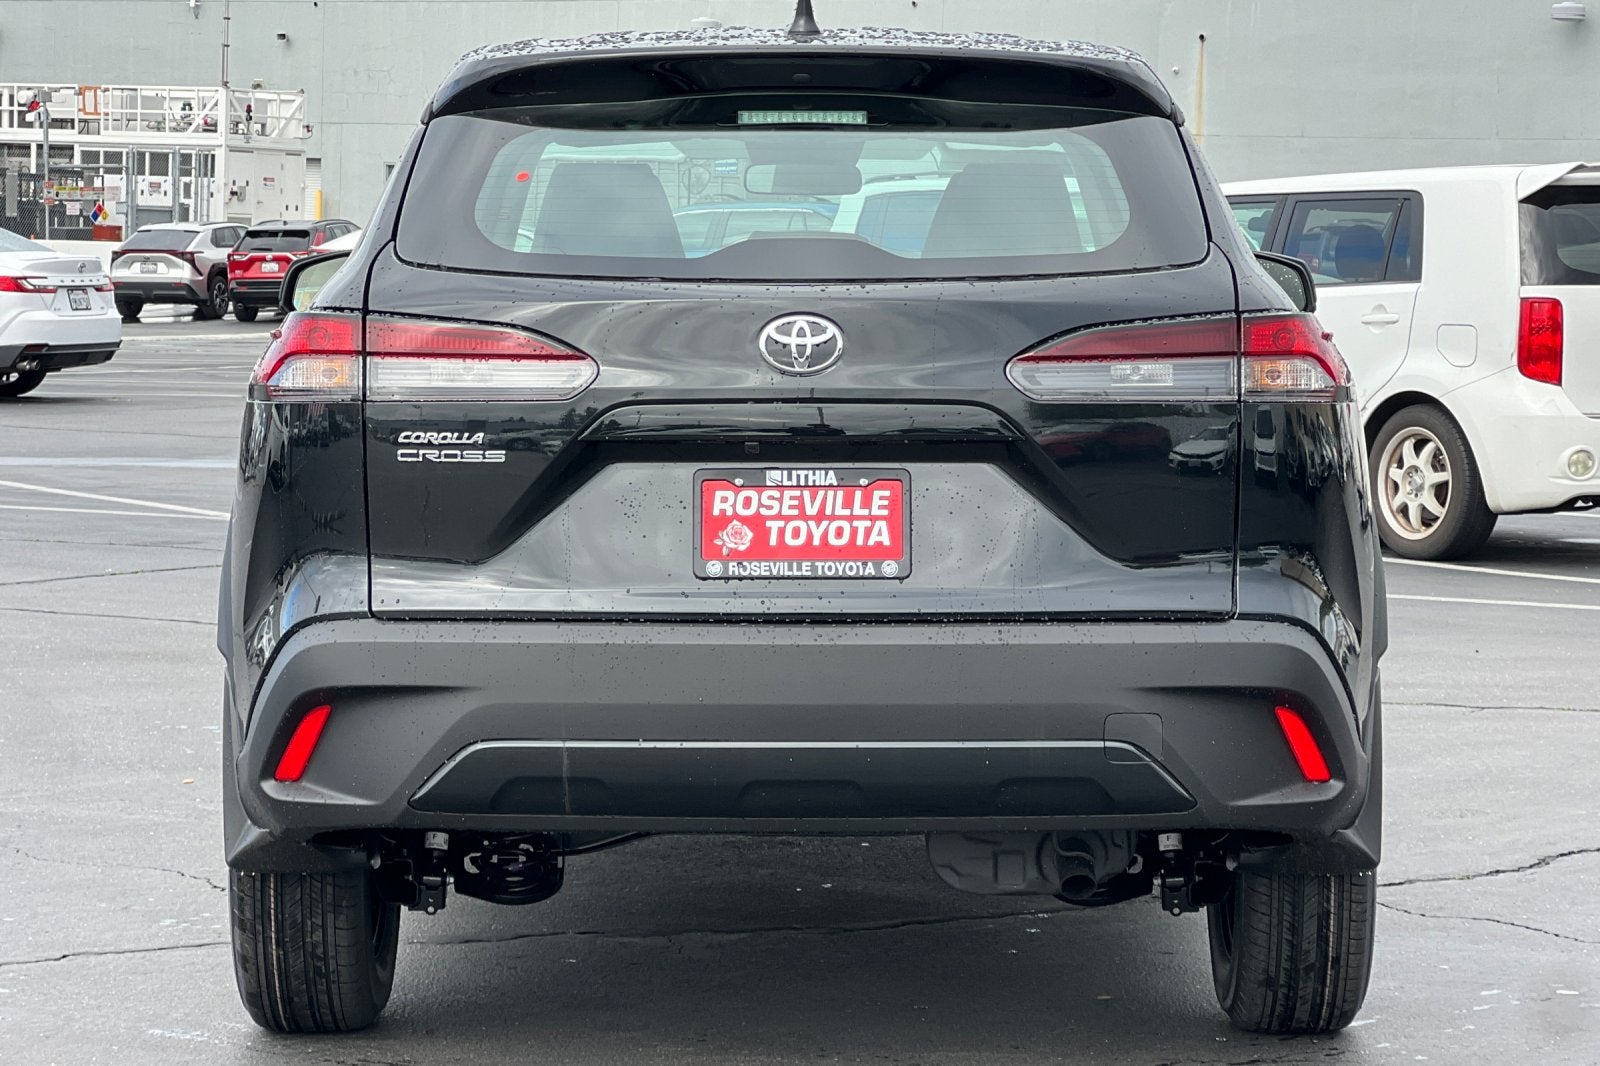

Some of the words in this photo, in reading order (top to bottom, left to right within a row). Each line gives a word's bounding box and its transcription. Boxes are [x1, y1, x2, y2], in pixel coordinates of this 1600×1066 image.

[397, 431, 484, 444] COROLLA
[397, 449, 506, 462] CROSS
[782, 470, 837, 486] LITHIA
[713, 490, 890, 516] ROSEVILLE
[766, 520, 891, 546] TOYOTA
[728, 562, 811, 576] ROSEVILLE
[815, 562, 875, 576] TOYOTA
